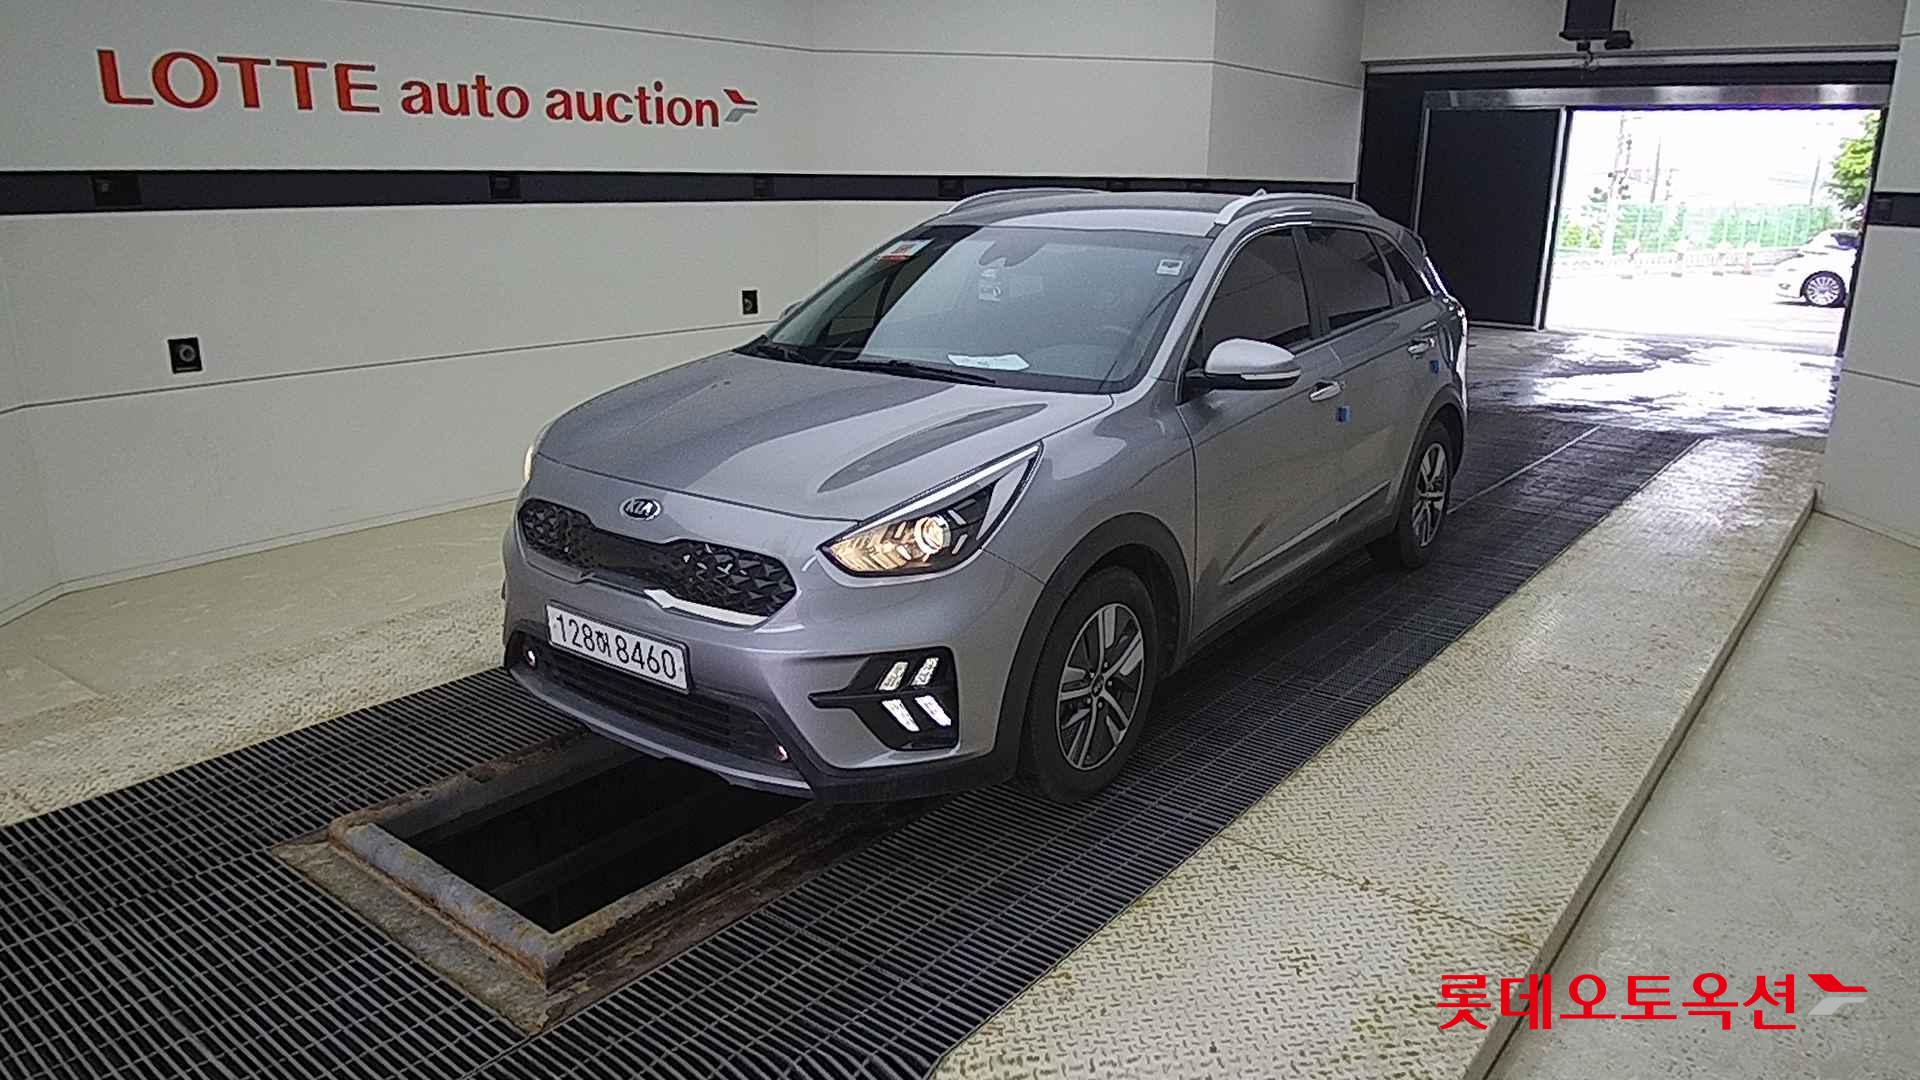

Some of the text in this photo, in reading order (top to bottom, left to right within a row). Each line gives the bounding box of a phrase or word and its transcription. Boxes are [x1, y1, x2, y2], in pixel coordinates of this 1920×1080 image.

[96, 48, 721, 128] LOTTE auto auction
